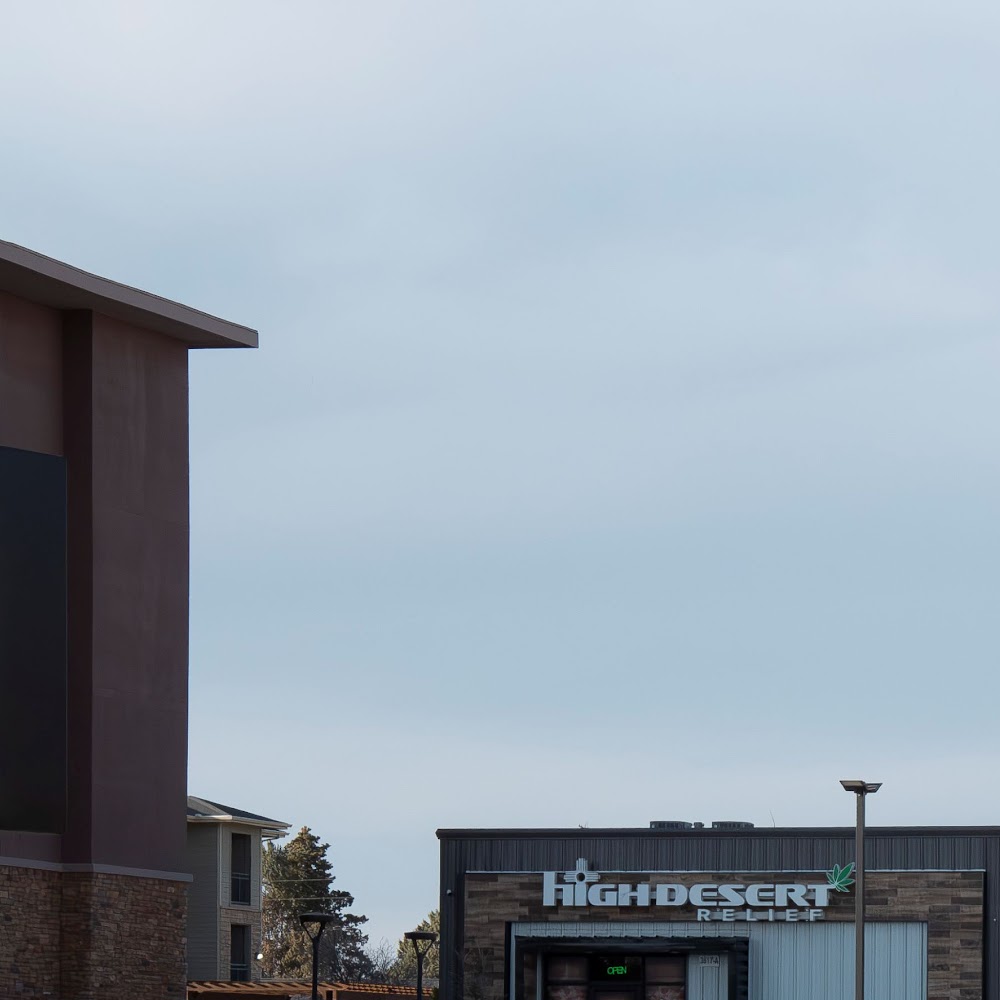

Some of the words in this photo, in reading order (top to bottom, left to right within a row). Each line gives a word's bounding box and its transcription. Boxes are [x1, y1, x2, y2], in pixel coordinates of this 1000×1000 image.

[655, 883, 834, 907] DESERT
[697, 908, 825, 922] RELIEF
[606, 966, 627, 975] OPEN
